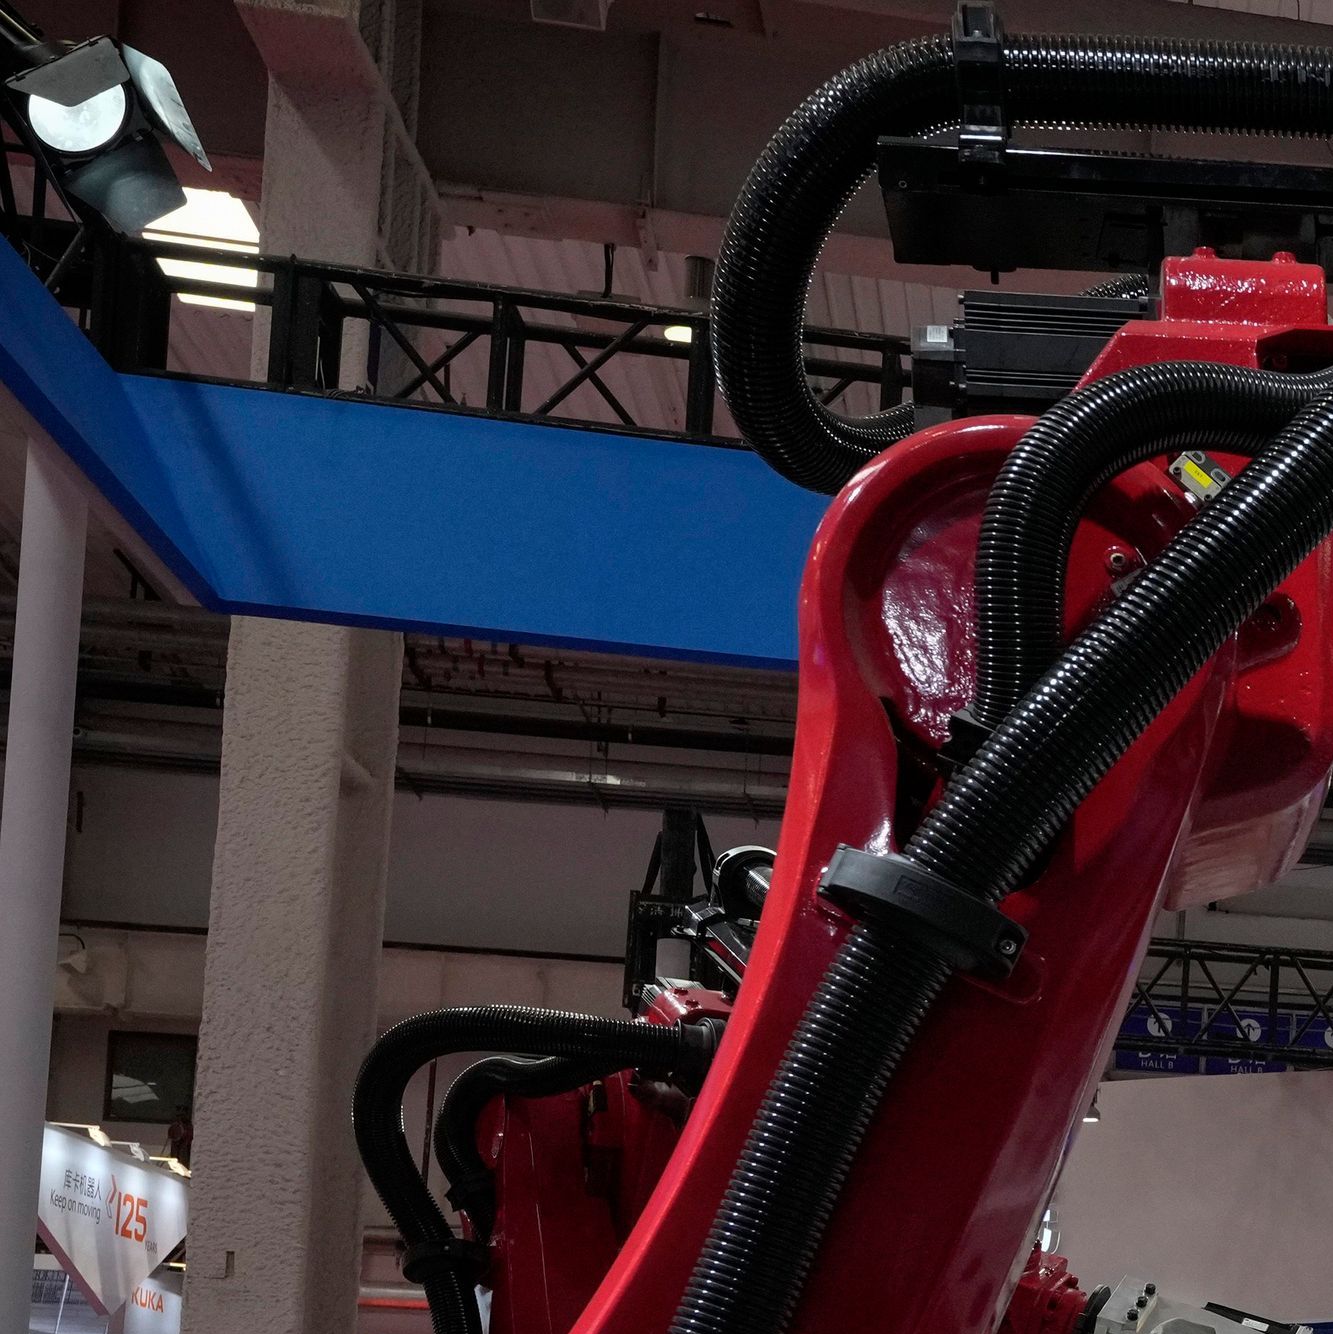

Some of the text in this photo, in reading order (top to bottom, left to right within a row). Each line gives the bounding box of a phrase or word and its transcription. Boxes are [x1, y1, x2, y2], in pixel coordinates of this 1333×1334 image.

[1140, 1059, 1165, 1069] HALL
[50, 1190, 101, 1225] Keep on moving
[115, 1191, 148, 1242] 125
[131, 1286, 164, 1313] KUKA
